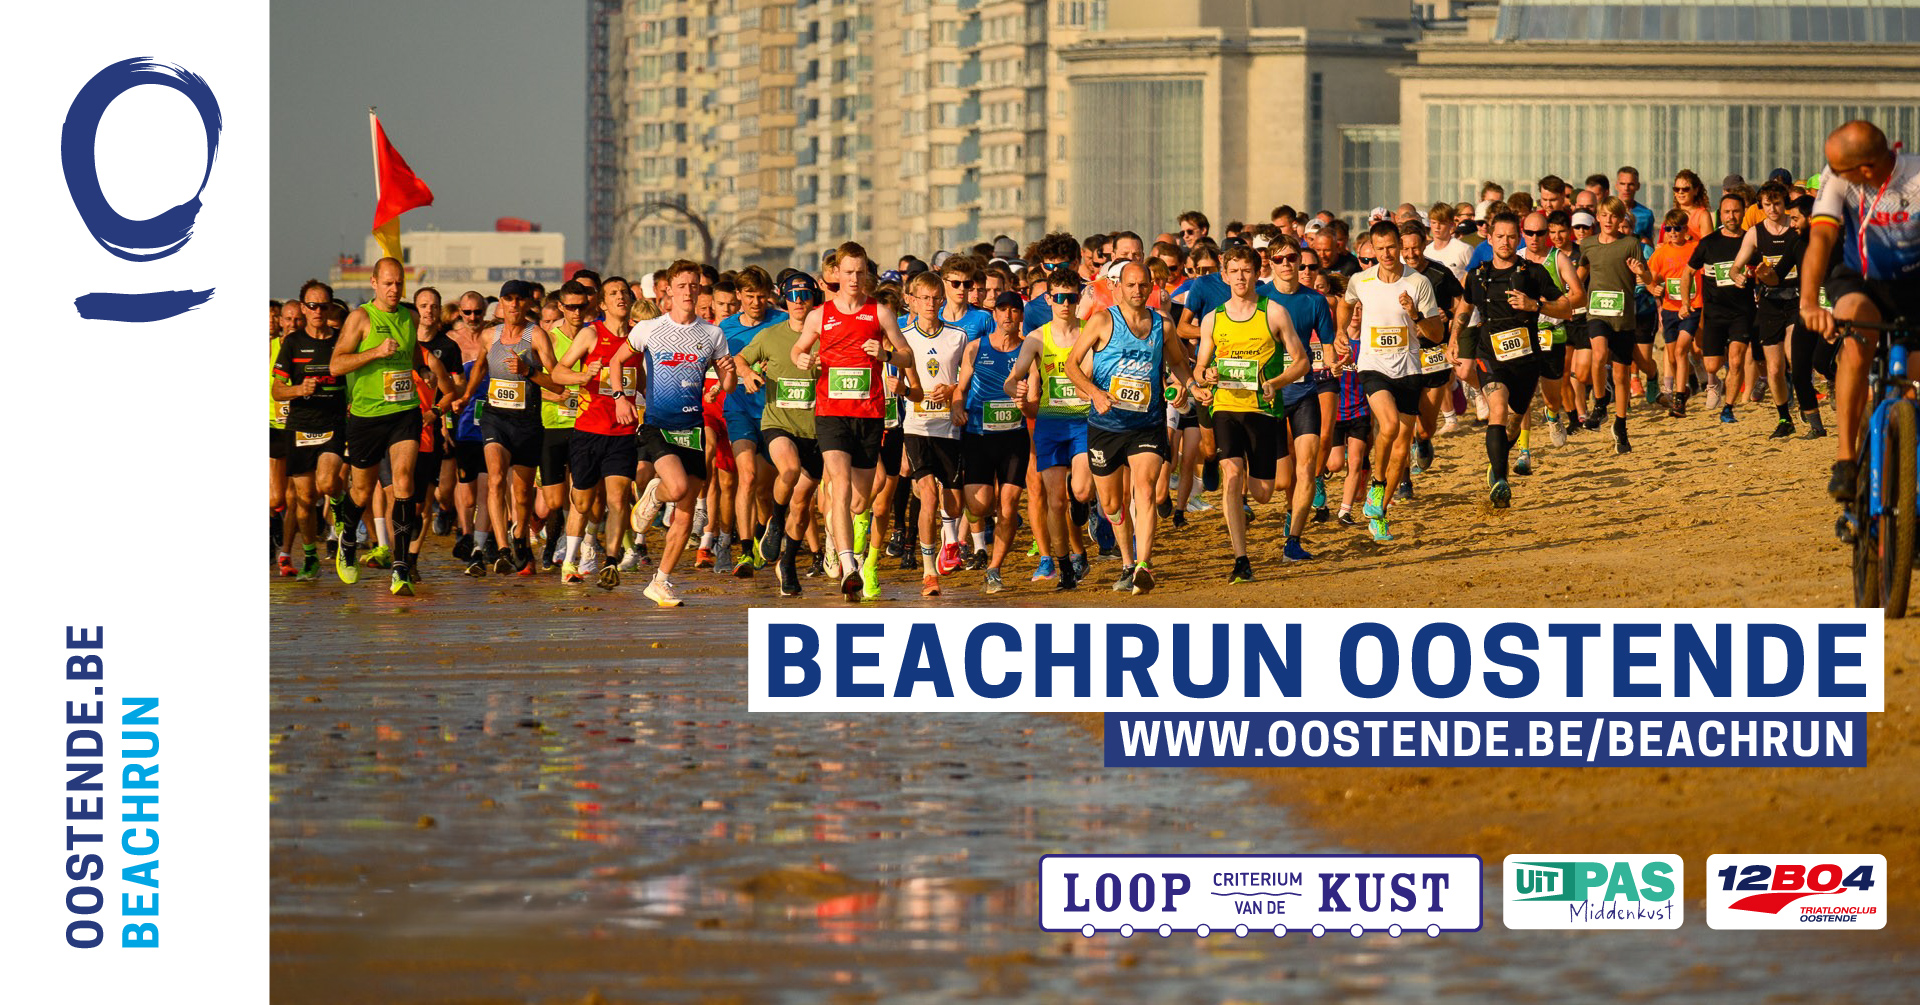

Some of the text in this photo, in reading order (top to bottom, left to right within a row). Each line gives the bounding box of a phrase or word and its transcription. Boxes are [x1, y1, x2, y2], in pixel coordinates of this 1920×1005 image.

[1380, 335, 1398, 345] 561
[1502, 337, 1521, 351] 580
[395, 380, 411, 391] 523
[841, 378, 858, 389] 137
[497, 389, 514, 400] 696
[788, 389, 805, 399] 207
[1121, 389, 1140, 401] 628
[994, 411, 1012, 421] 103
